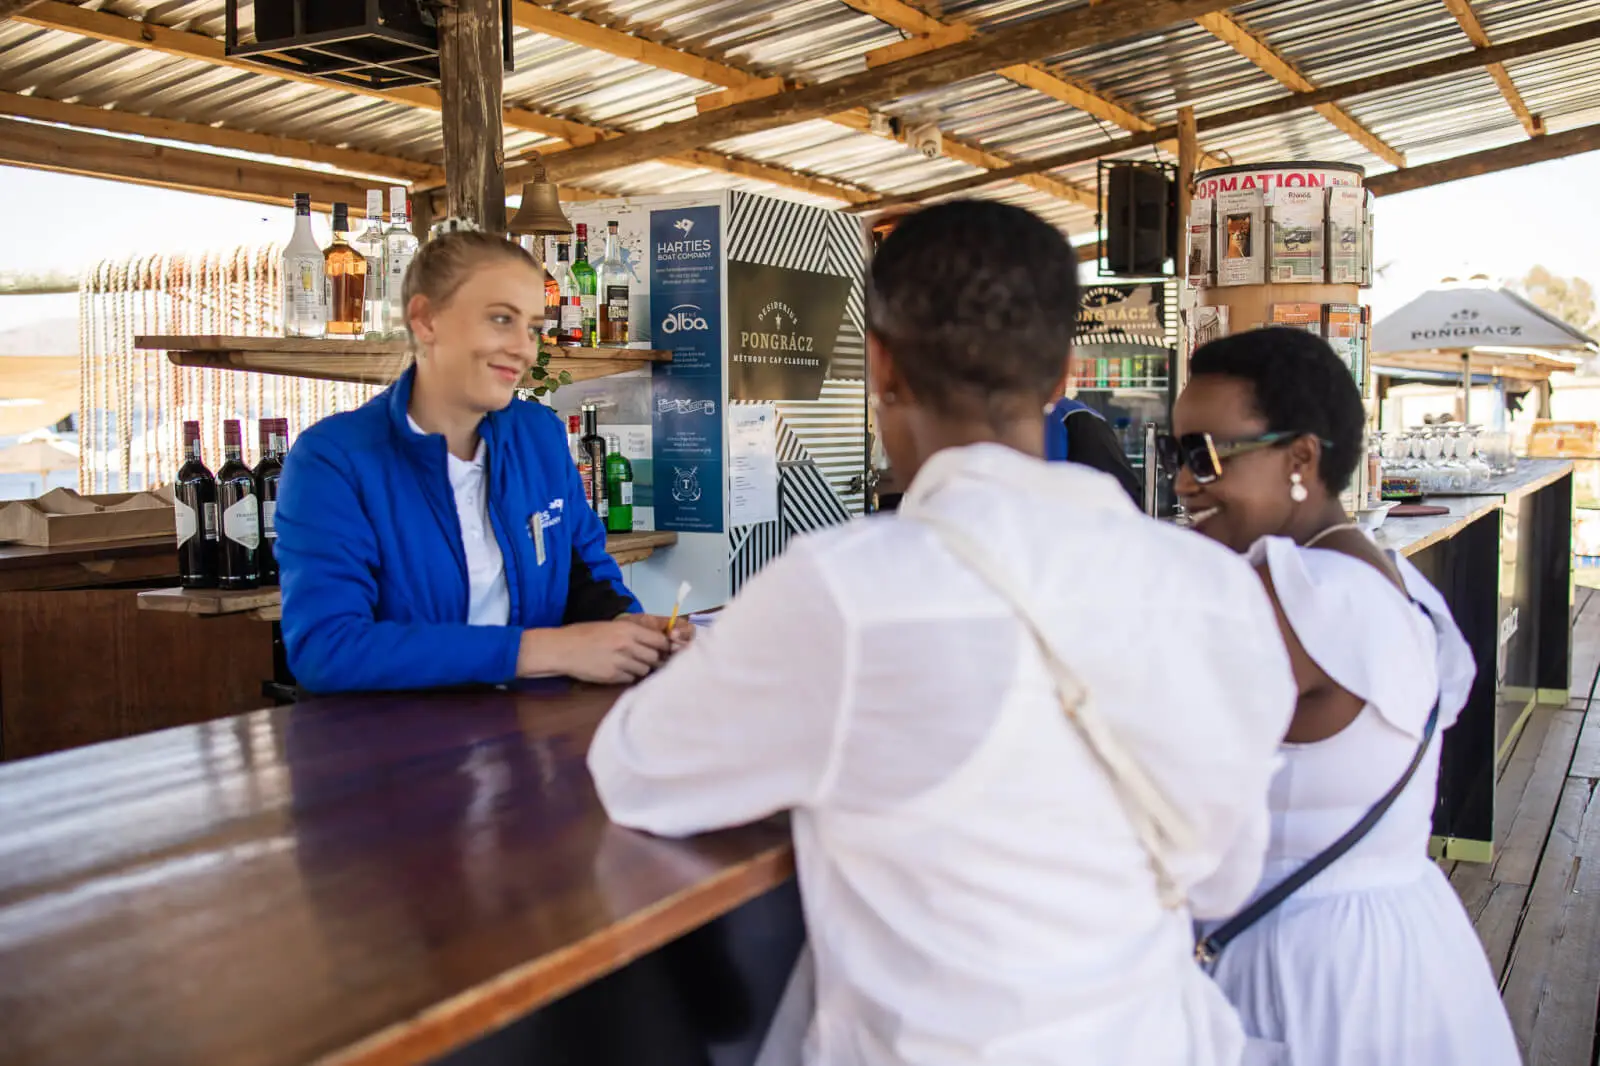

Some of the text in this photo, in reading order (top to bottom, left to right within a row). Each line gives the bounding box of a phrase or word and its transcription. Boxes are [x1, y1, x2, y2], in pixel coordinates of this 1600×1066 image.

[657, 240, 712, 254] HARTIES
[657, 251, 712, 261] BOAT COMPANY
[758, 301, 798, 325] DESIDERIUS
[740, 331, 814, 352] PONGRÁCZ
[783, 358, 820, 367] CLASSIQUE
